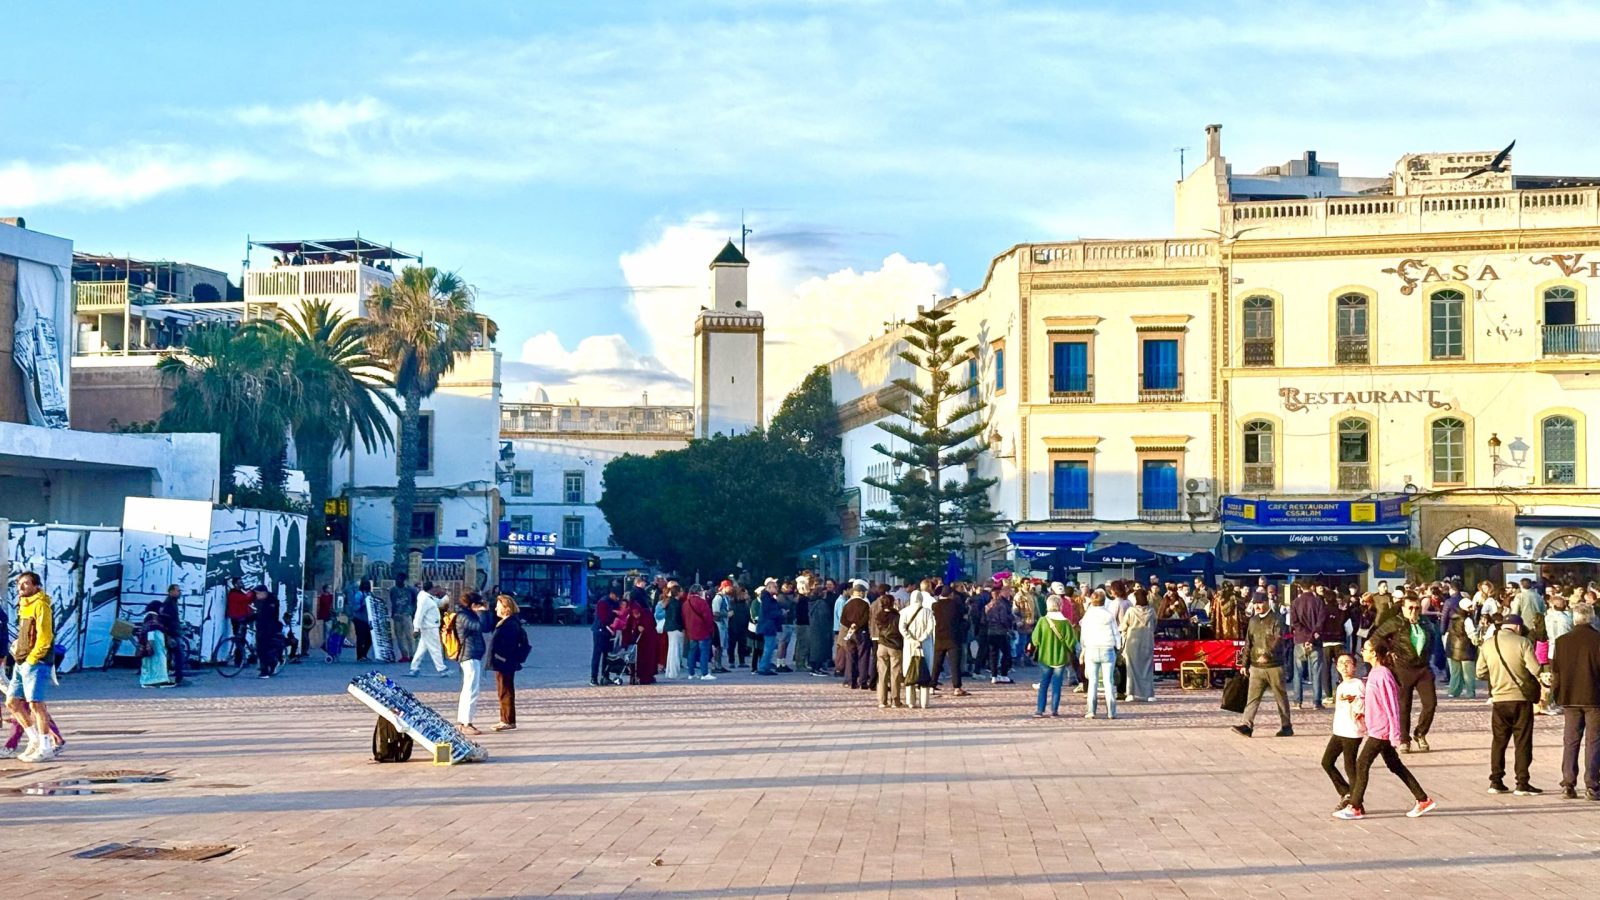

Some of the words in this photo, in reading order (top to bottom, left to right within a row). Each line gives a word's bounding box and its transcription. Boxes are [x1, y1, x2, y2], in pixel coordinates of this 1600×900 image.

[1381, 258, 1500, 296] CASA
[1279, 387, 1452, 413] RESTAURANT
[508, 532, 557, 542] CRÊPES
[1289, 534, 1314, 544] Unique
